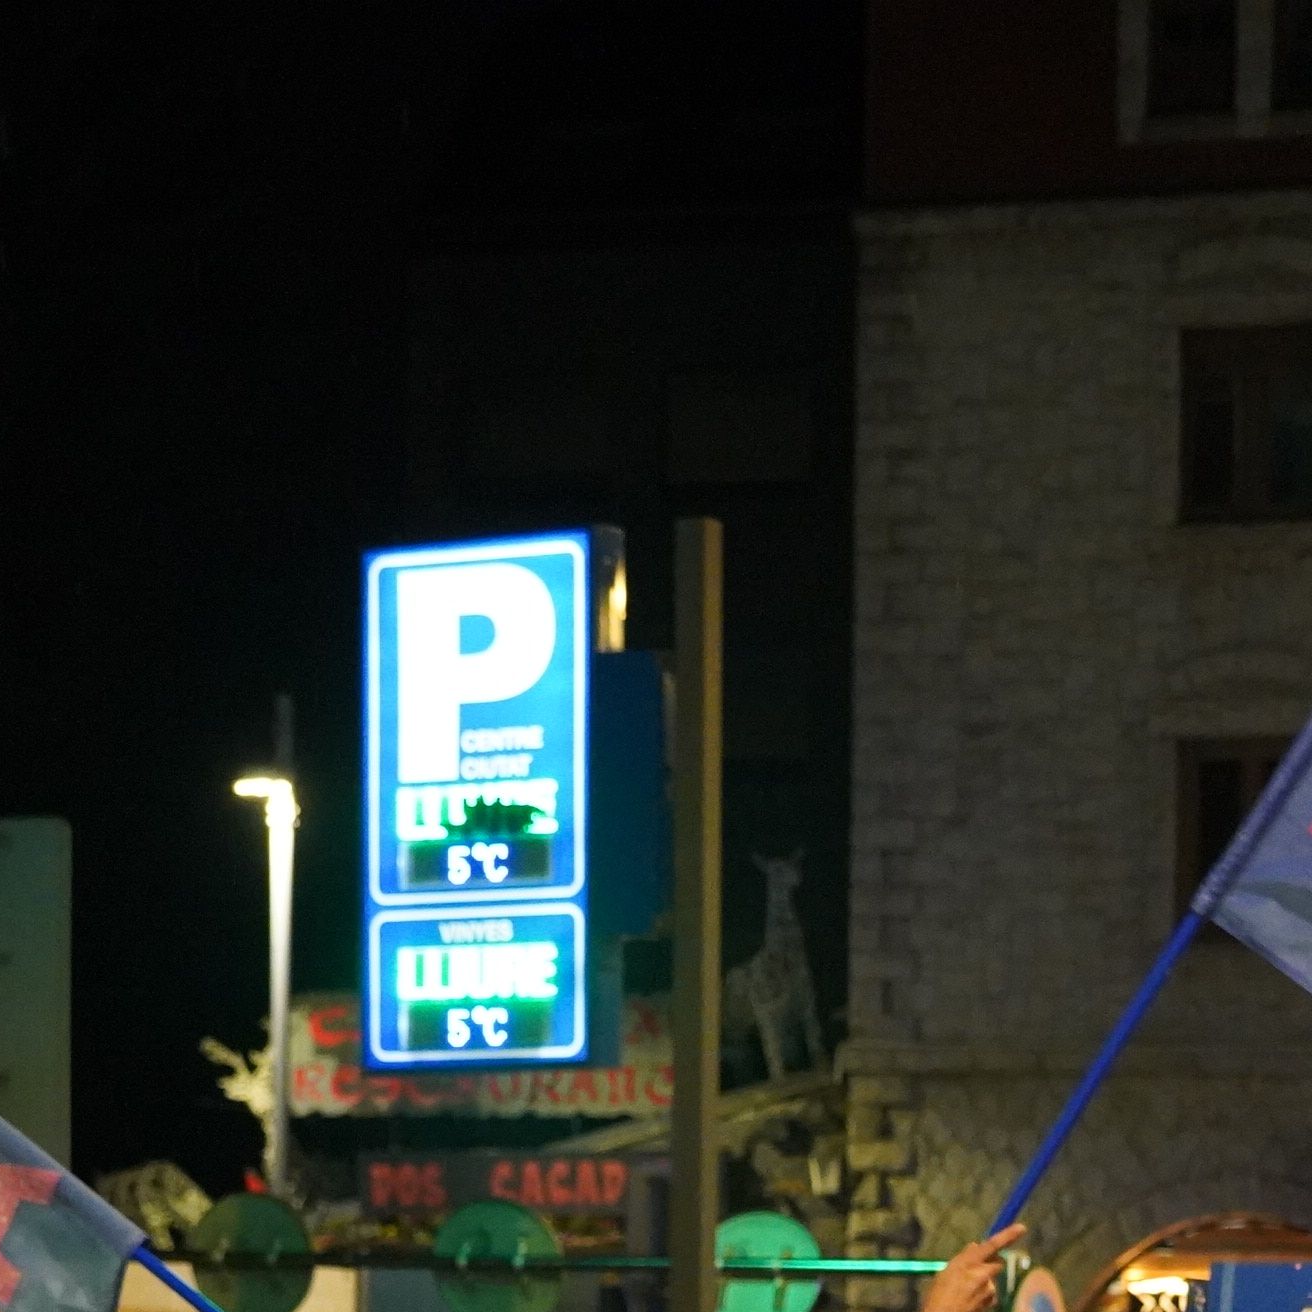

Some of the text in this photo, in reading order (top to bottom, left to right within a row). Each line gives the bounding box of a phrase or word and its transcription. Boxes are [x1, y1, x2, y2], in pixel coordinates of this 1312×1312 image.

[396, 562, 557, 783] P
[461, 725, 543, 754] CENTRE
[447, 842, 509, 885] 5°C
[439, 918, 514, 944] VINYES
[447, 1005, 509, 1048] 5°C
